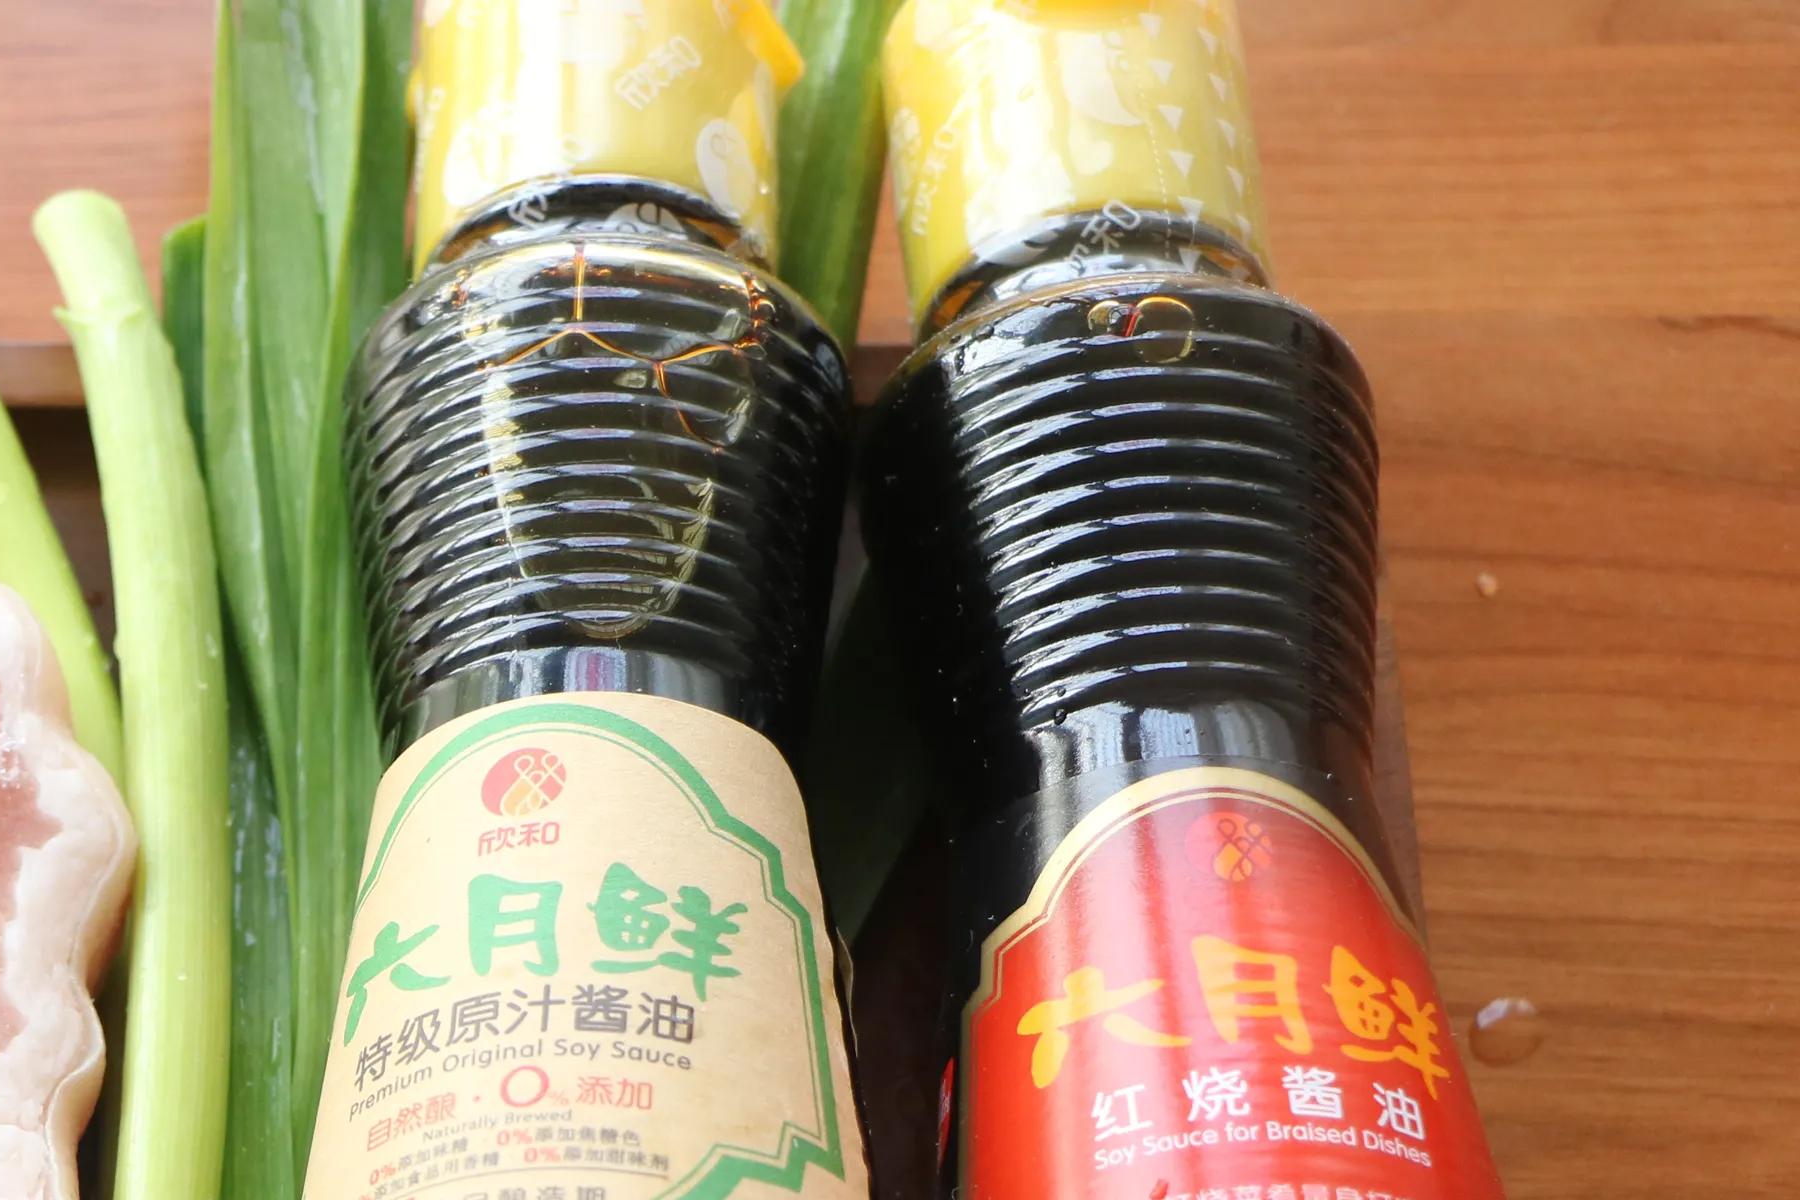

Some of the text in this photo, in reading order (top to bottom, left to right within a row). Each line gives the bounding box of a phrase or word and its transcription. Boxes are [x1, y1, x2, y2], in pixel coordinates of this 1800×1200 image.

[477, 821, 561, 857] 欣和
[343, 862, 748, 1047] 六月鲜
[354, 984, 695, 1092] 特级原汁酱油
[1017, 934, 1450, 1099] 六月鲜
[349, 1038, 692, 1121] Premium Original Soy Sauce
[1091, 1065, 1425, 1142] 红烧酱油
[422, 1109, 573, 1143] Naturally Brewed
[1094, 1120, 1433, 1171] Soy Sauce for Braised Dishes
